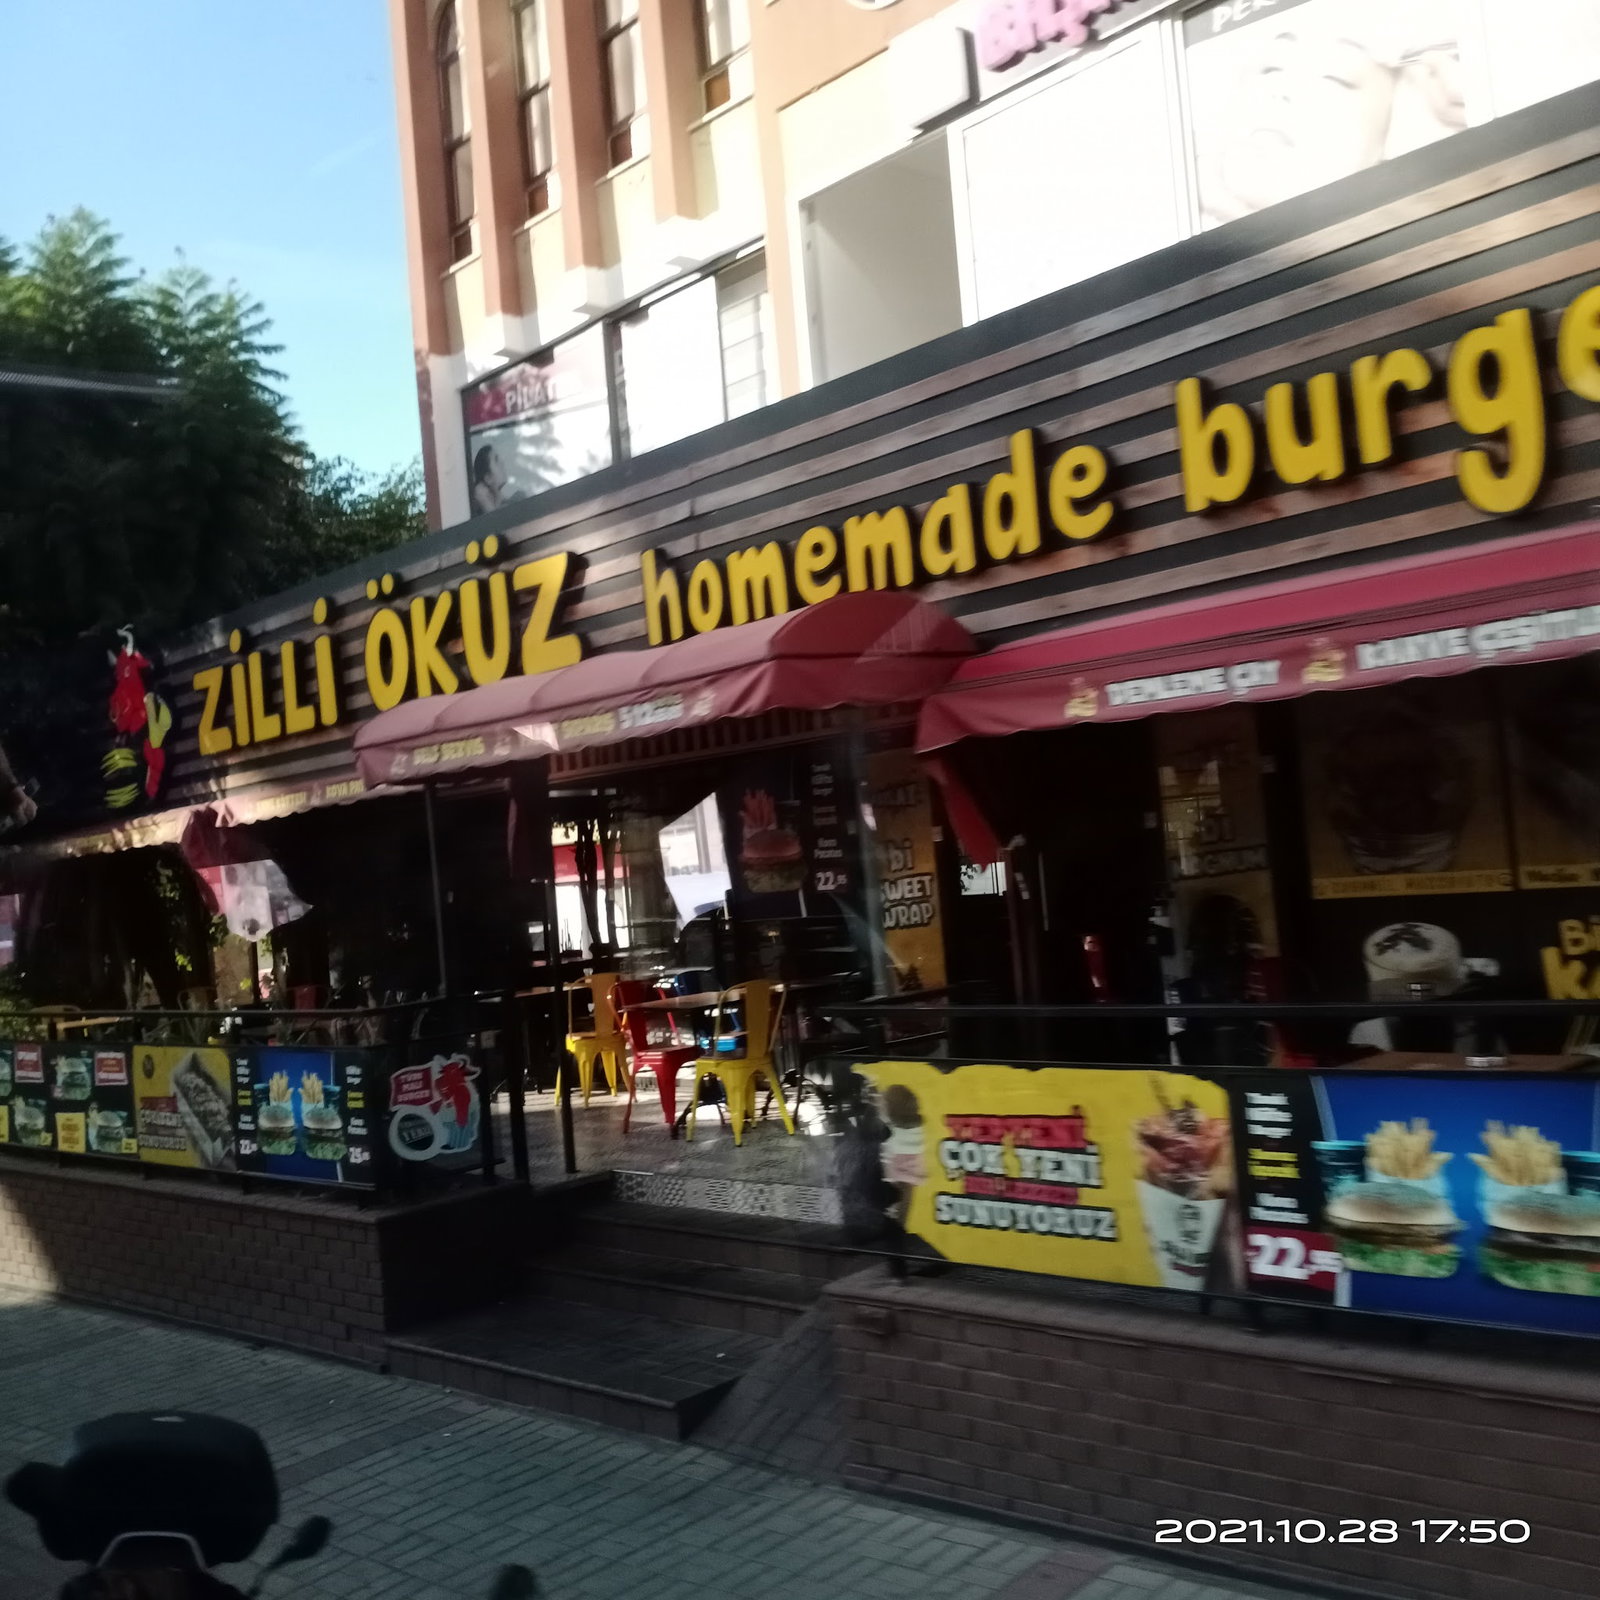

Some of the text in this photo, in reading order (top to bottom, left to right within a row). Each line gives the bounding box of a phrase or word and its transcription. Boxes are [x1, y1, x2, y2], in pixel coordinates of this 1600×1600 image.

[193, 597, 338, 755] ZİLLİ
[364, 534, 582, 712] ÖKÜZ
[641, 428, 1114, 647] homemade
[1105, 666, 1226, 706] DEMLEME
[934, 1191, 1120, 1243] SUNUYORUZ
